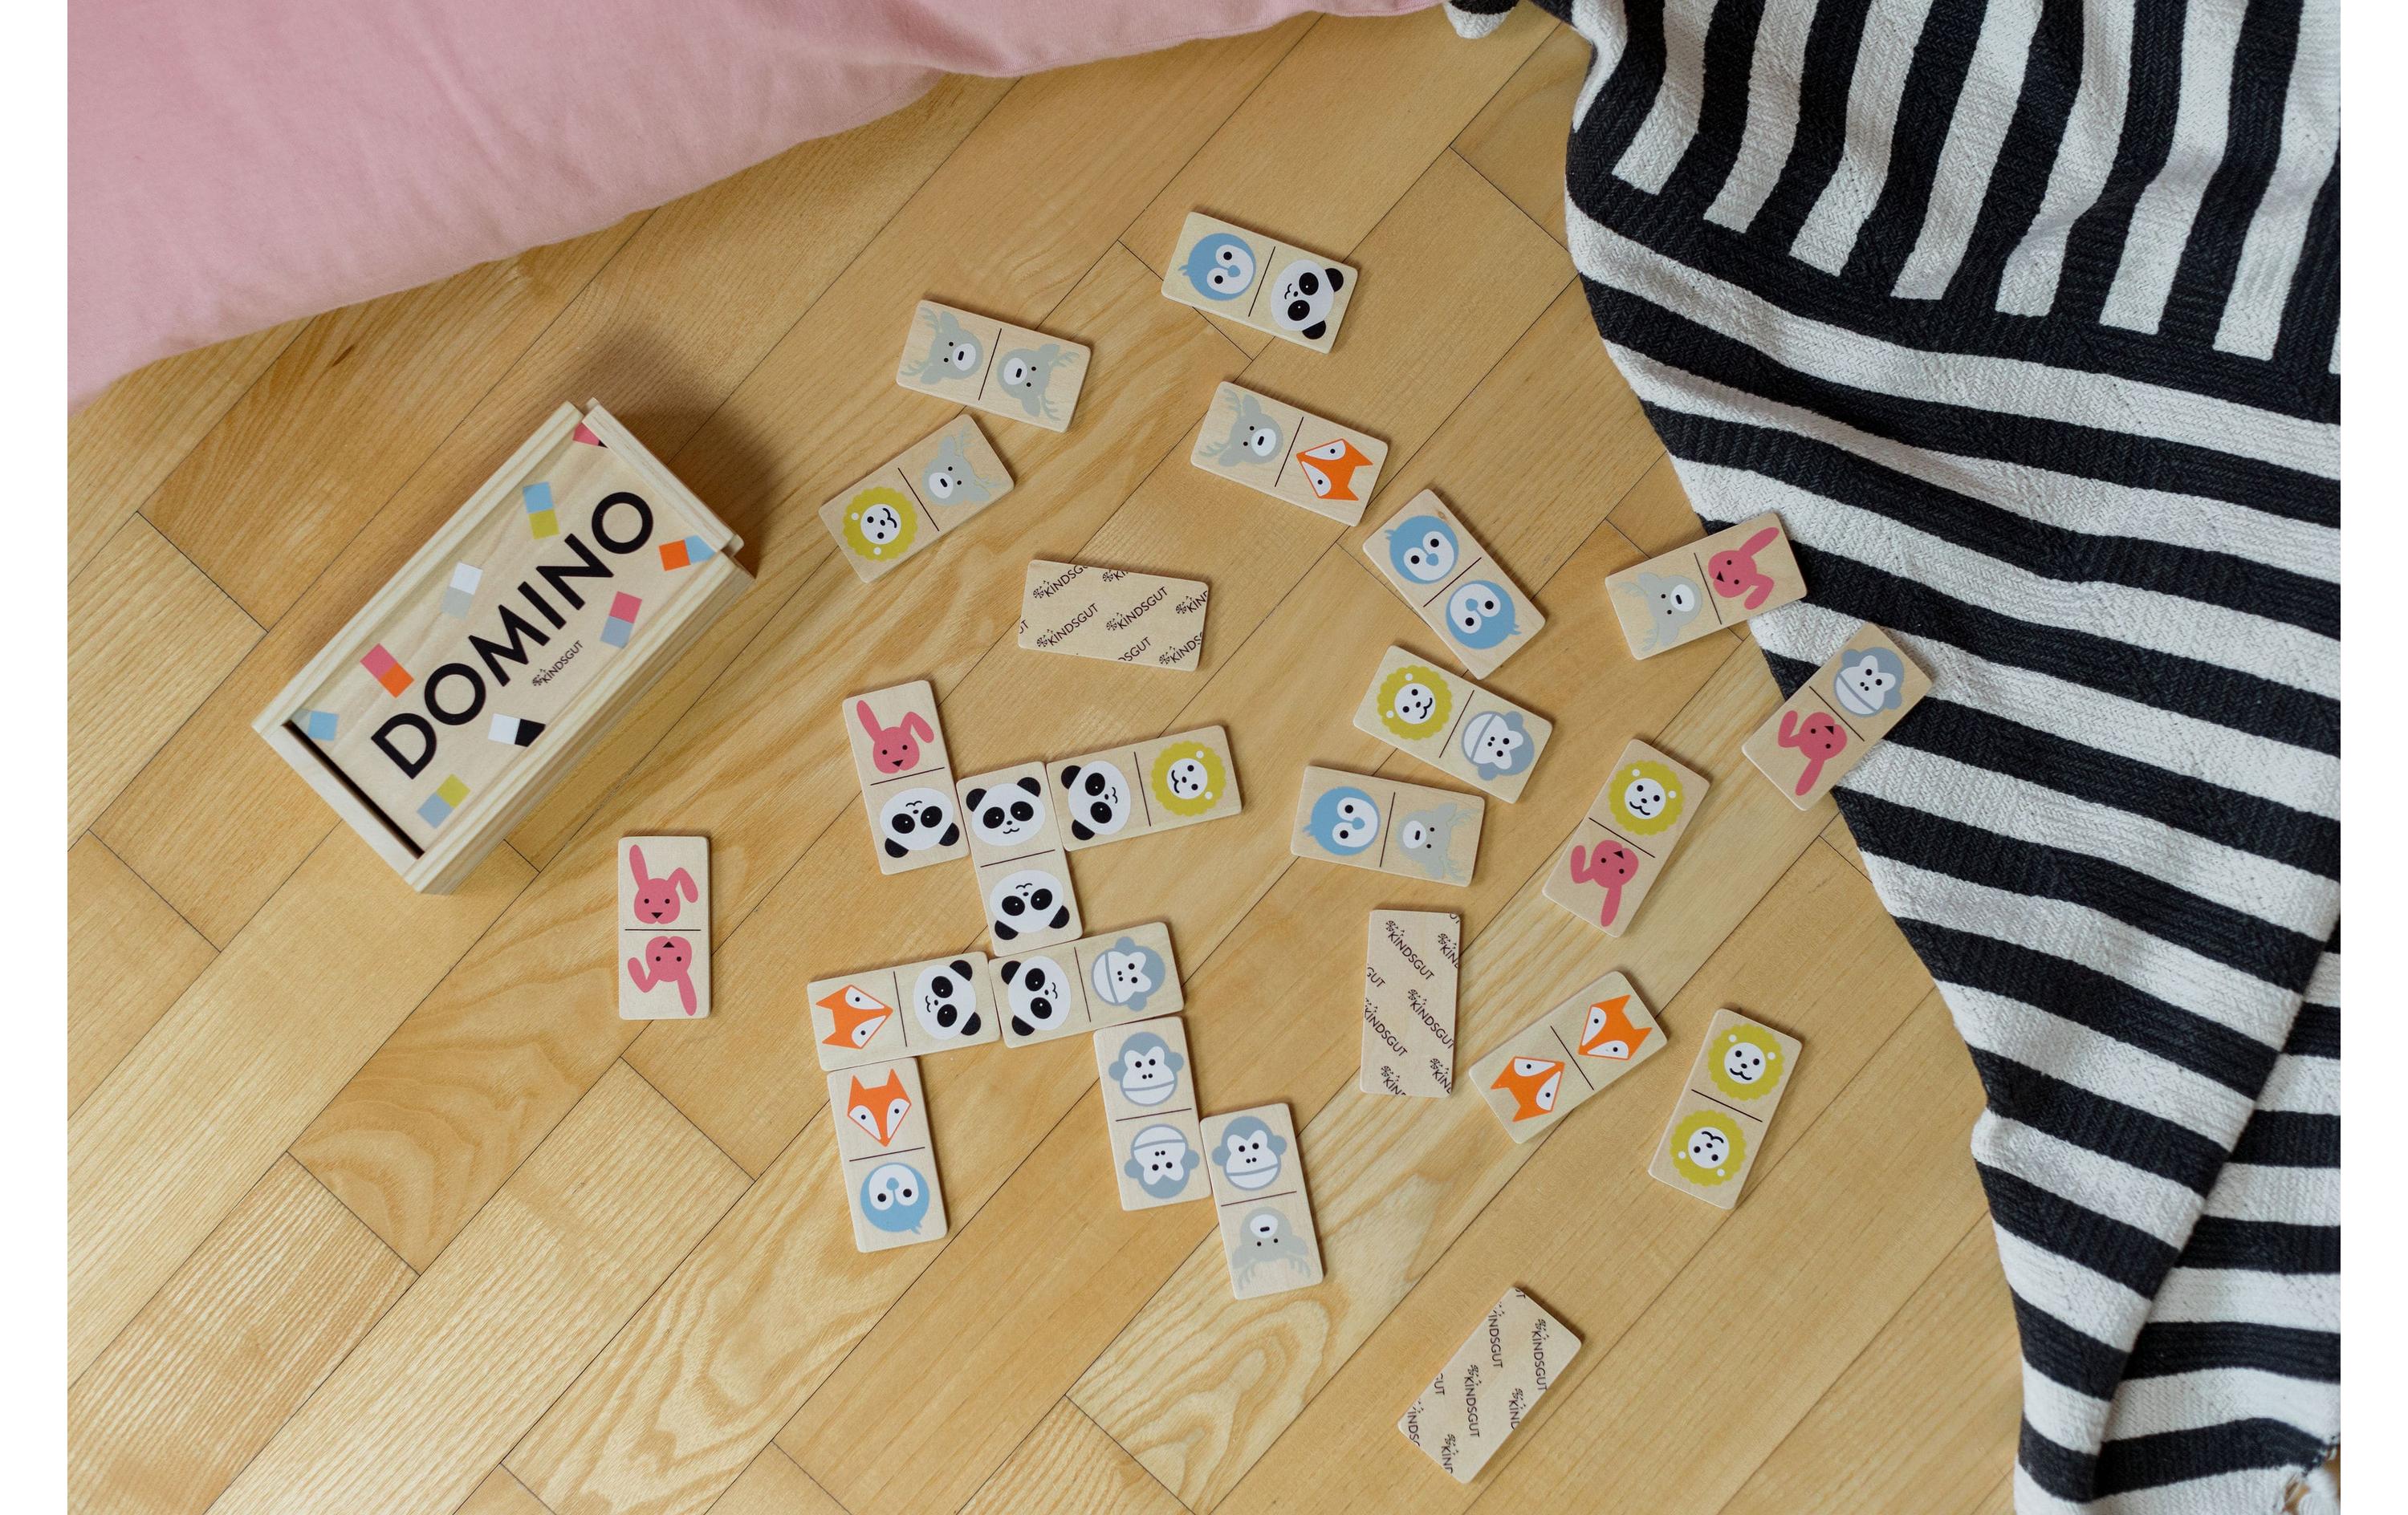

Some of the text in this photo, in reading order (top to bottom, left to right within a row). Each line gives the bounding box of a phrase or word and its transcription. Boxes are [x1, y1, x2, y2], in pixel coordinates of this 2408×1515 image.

[1047, 603, 1099, 647] KINDSGUT
[1117, 587, 1168, 630] KINDSGUT
[371, 491, 653, 779] DOMINO
[1169, 632, 1202, 664] KINDS
[542, 640, 584, 684] KINDSGUT
[1388, 931, 1434, 980] KINDSGUT
[1409, 1000, 1454, 1049] KINDSGUT
[1488, 1310, 1503, 1368] INDSGUT
[1531, 1330, 1548, 1391] KINDSGUT
[1464, 1377, 1480, 1438] KINDSGUT
